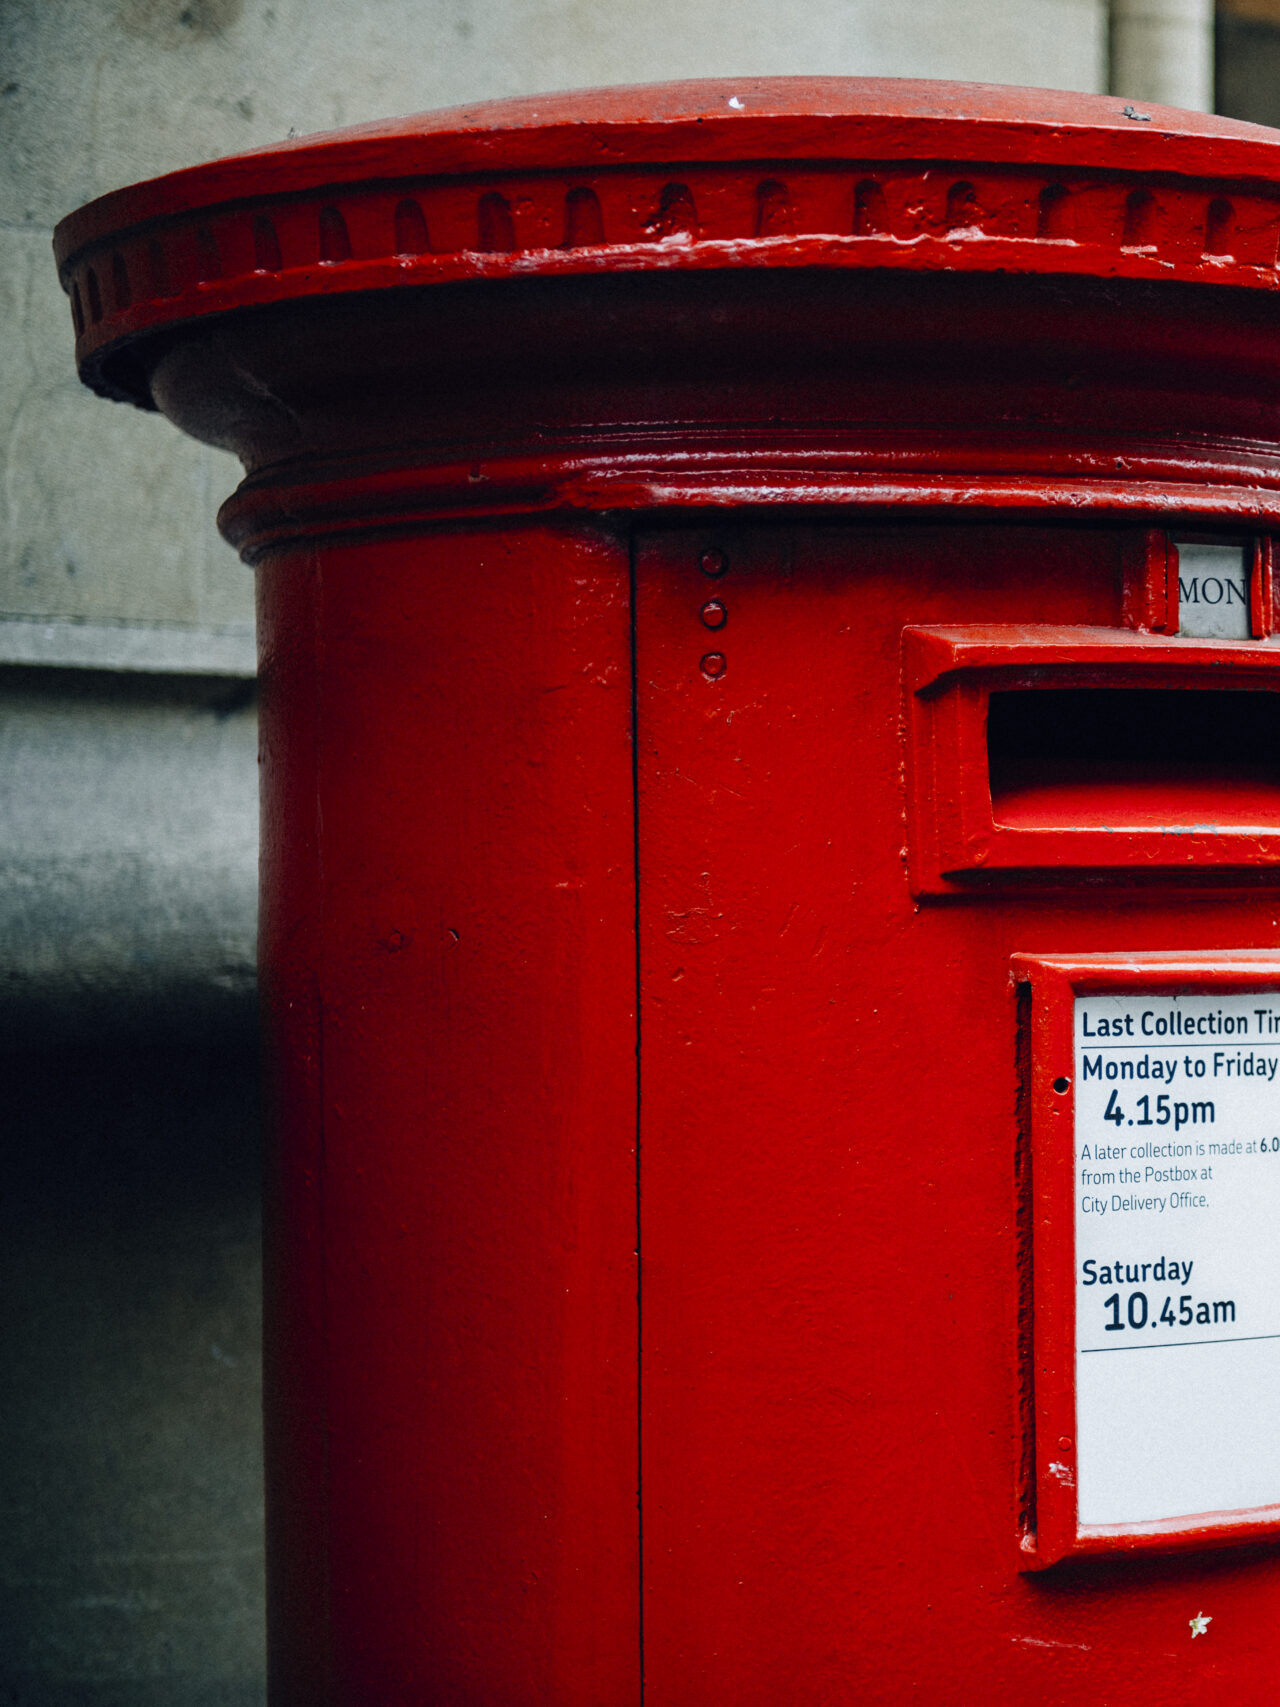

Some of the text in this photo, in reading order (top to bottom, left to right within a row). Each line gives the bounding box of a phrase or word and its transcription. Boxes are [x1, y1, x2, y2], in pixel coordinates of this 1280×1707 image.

[1178, 576, 1247, 606] MON
[1082, 1011, 1134, 1037] Last
[1141, 1010, 1248, 1036] Collection
[1082, 1052, 1279, 1084] Monday to Friday
[1103, 1088, 1215, 1131] 4.15pm
[1081, 1144, 1091, 1160] A
[1094, 1143, 1127, 1160] later
[1130, 1141, 1192, 1158] collection
[1195, 1140, 1206, 1156] is
[1208, 1139, 1243, 1155] made
[1245, 1140, 1258, 1153] at
[1081, 1165, 1213, 1185] from the Postbox at
[1081, 1192, 1210, 1216] City Delivery Office.
[1082, 1256, 1193, 1286] Saturday
[1103, 1291, 1236, 1331] 10.45am
